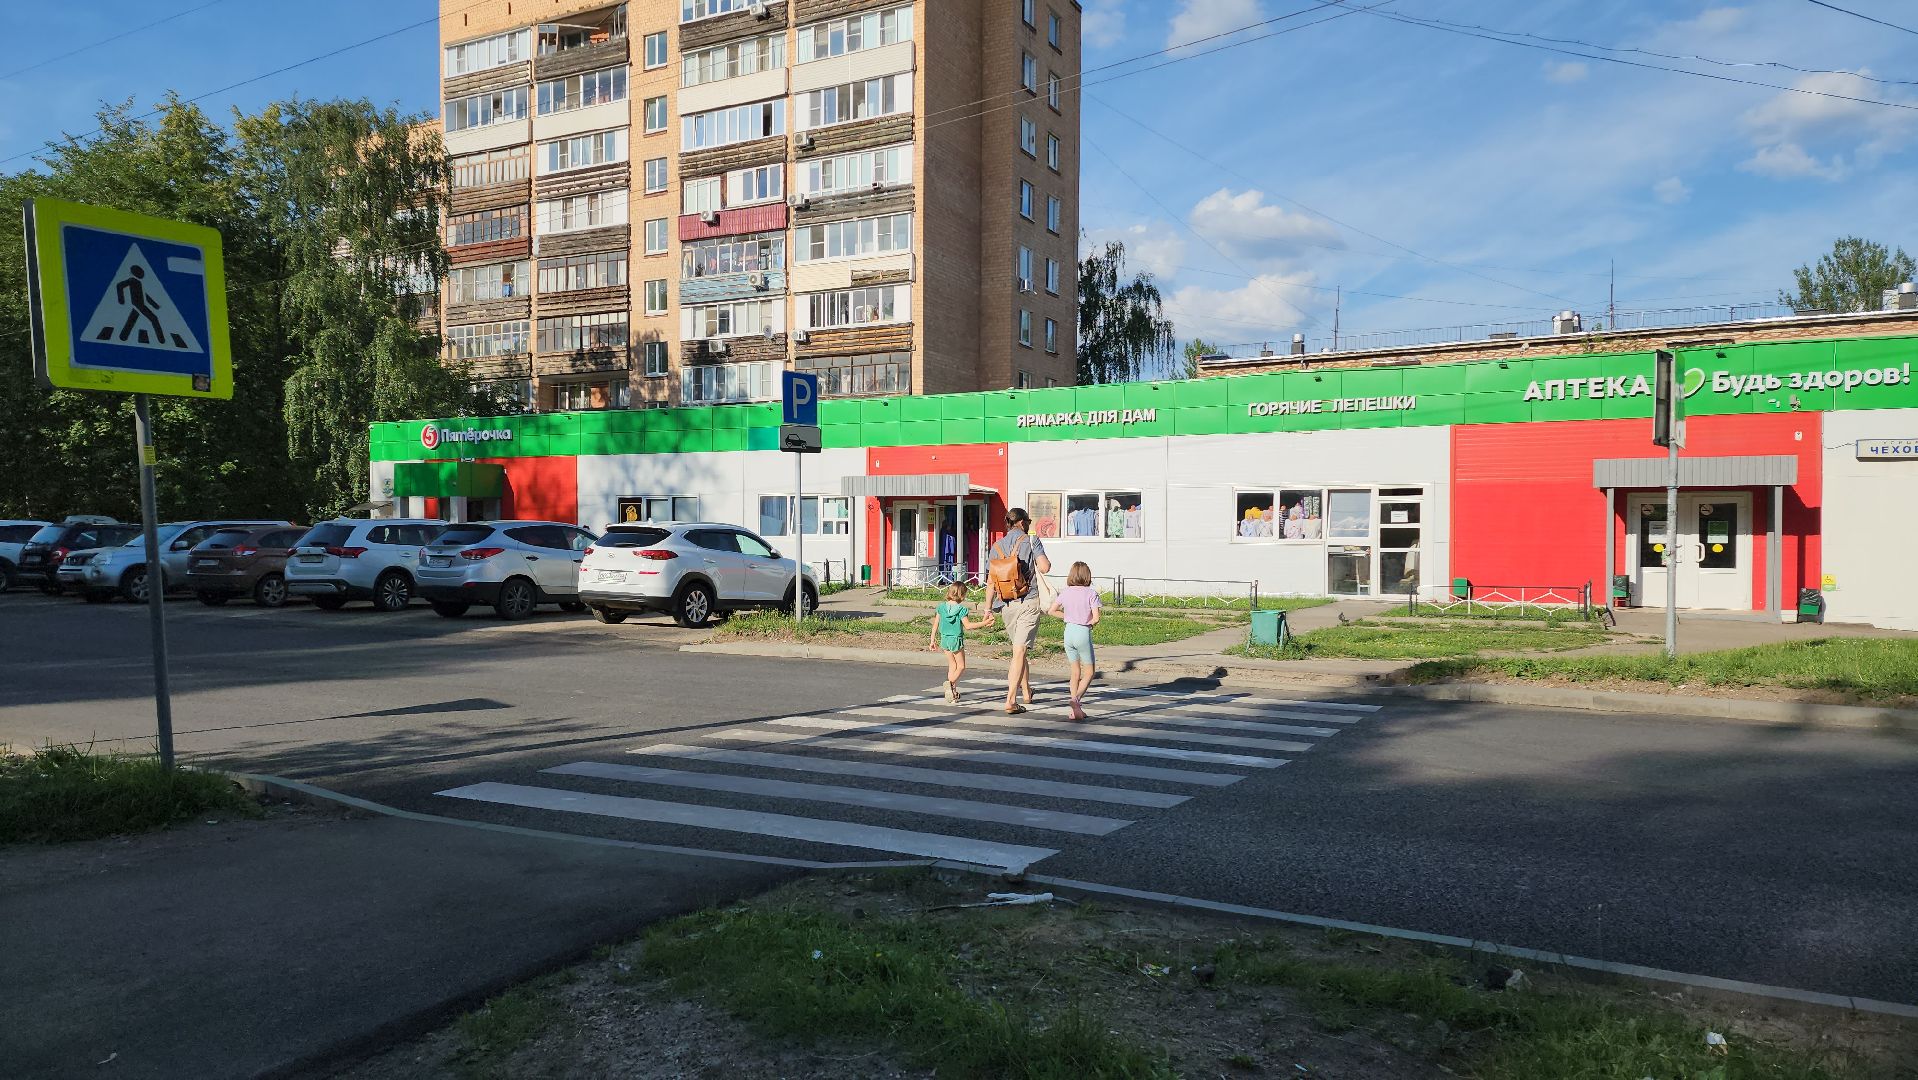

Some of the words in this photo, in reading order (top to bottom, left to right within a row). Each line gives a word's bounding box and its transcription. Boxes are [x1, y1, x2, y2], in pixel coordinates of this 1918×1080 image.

[1523, 374, 1652, 401] АПТЕКА
[1712, 370, 1783, 397] Будь
[1788, 362, 1910, 392] здоров!
[1248, 399, 1322, 416] ГОРЯЧИЕ
[1332, 396, 1416, 412] ЛЕПЕШКИ
[1017, 411, 1084, 427] ЯРМАРКА
[1087, 410, 1119, 426] ДЛЯ
[1122, 408, 1156, 425] ДАМ
[441, 427, 513, 444] Пятёрочка
